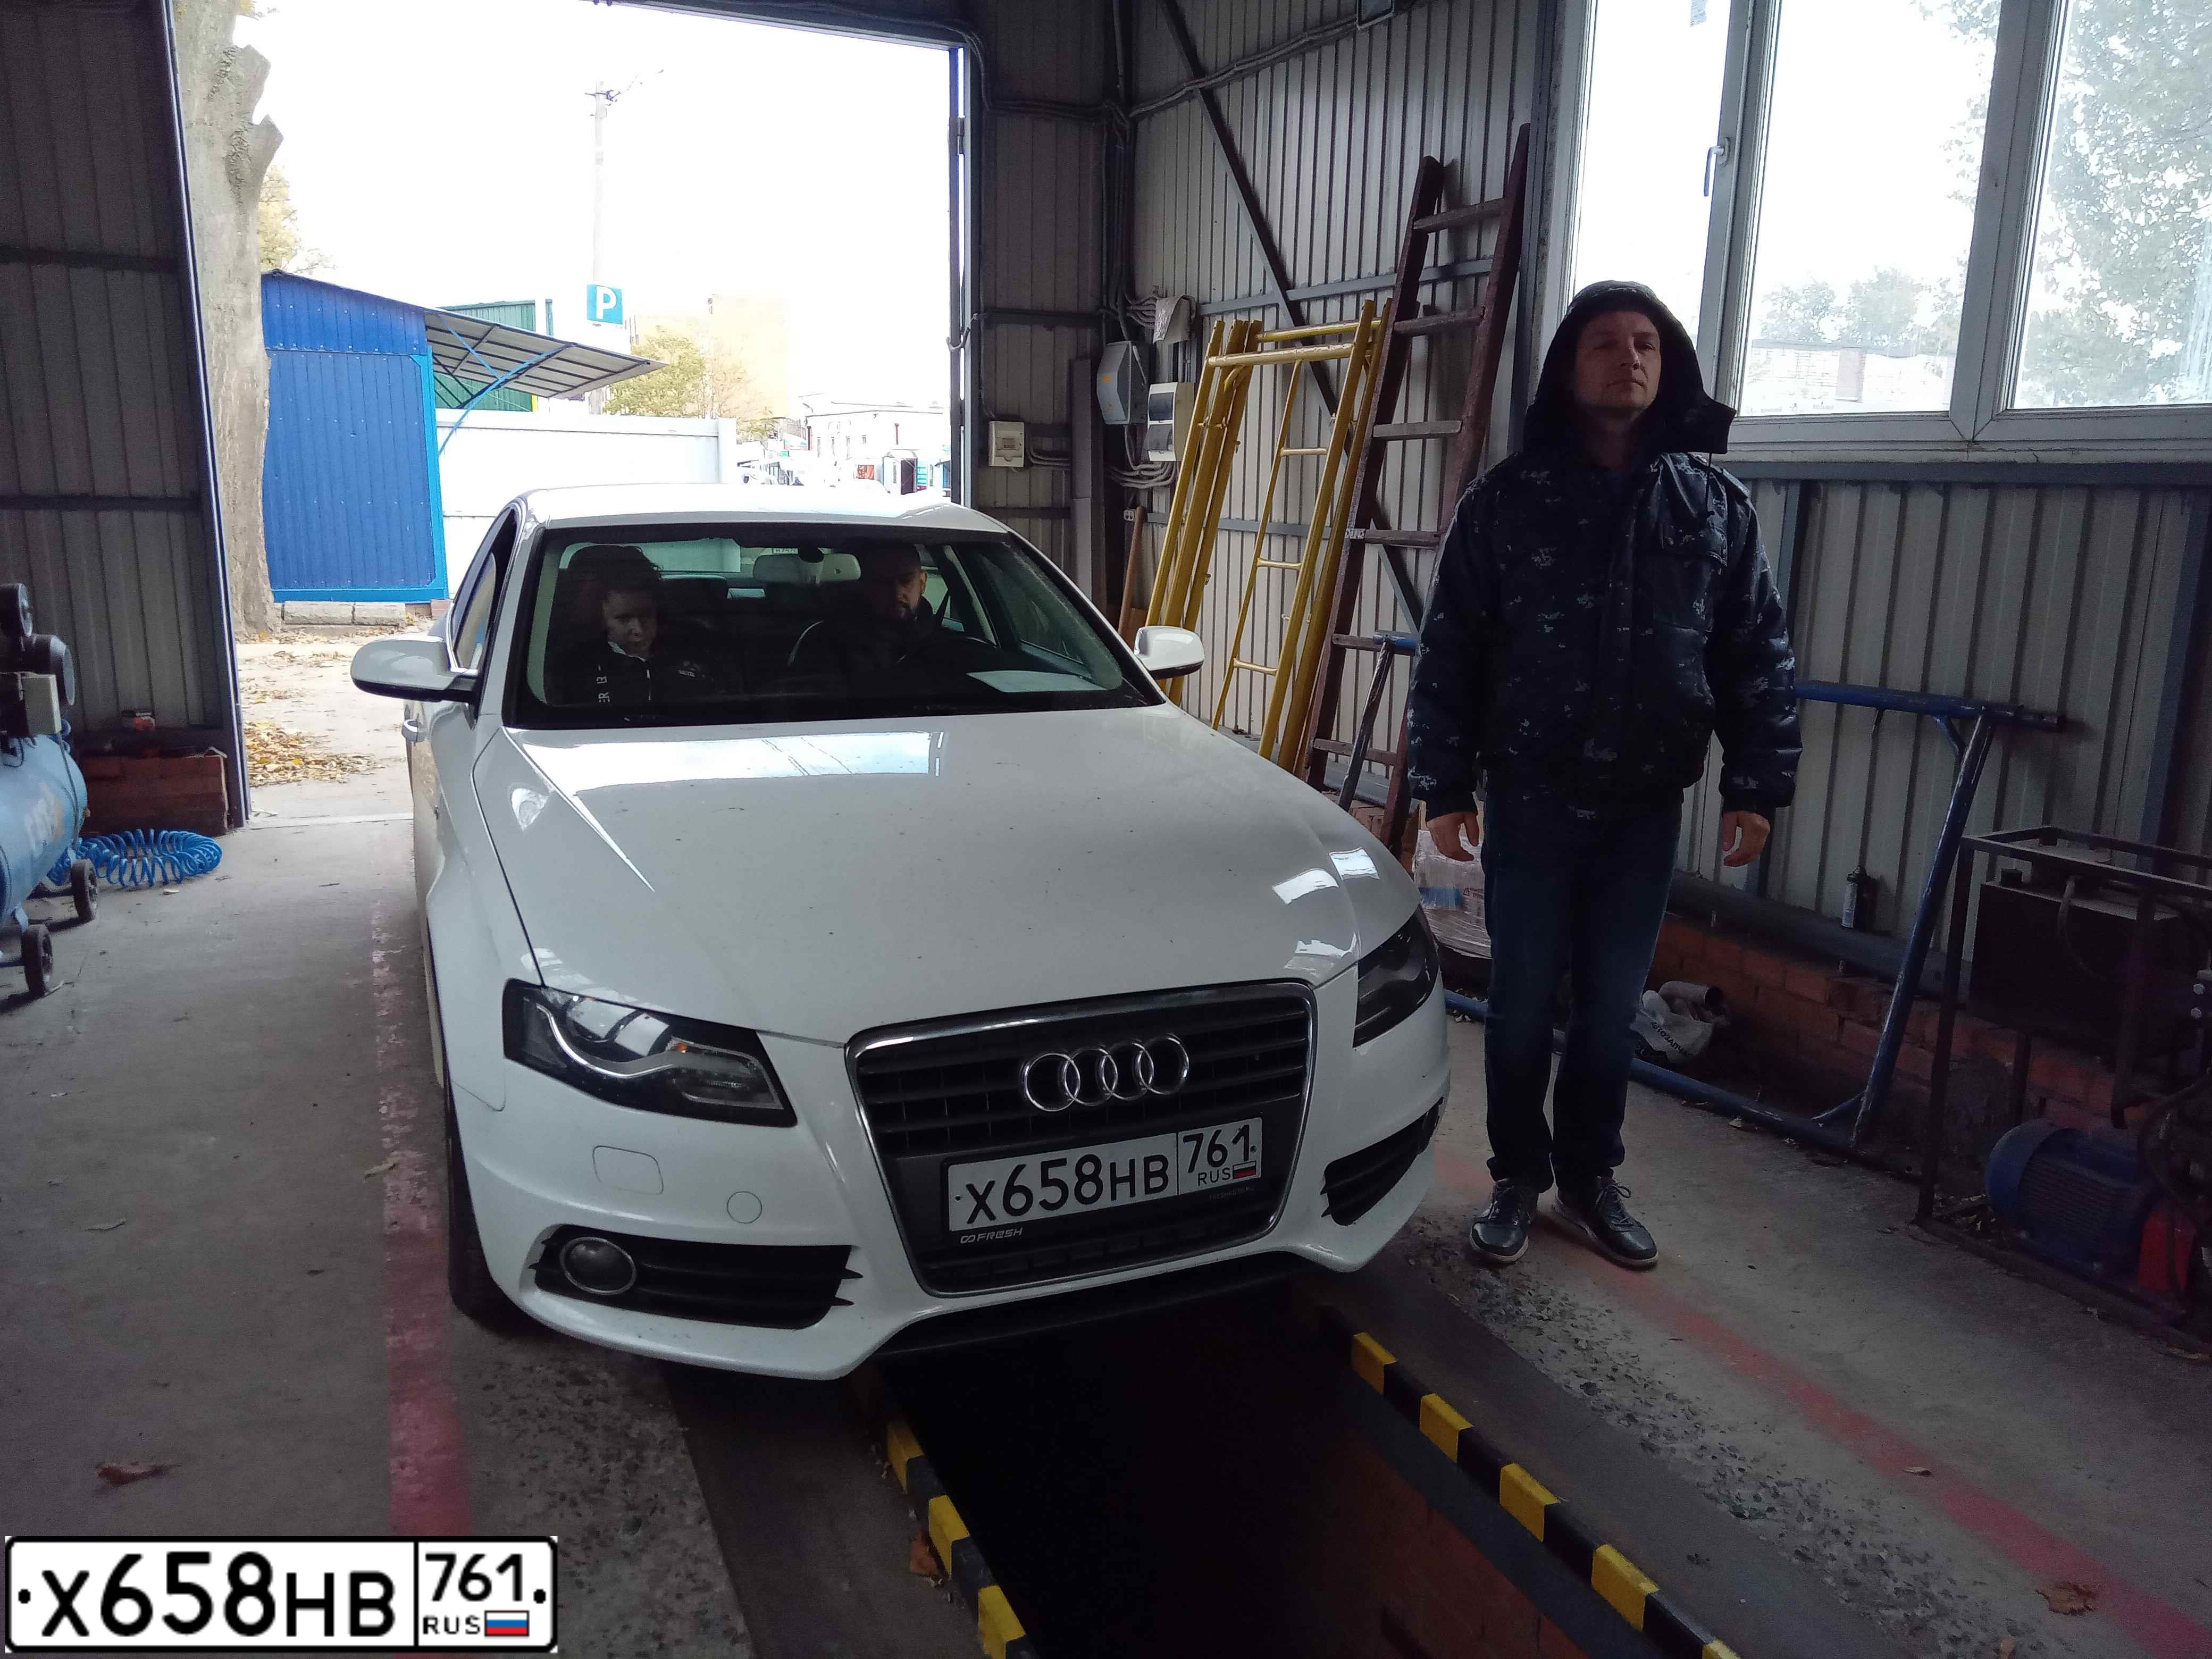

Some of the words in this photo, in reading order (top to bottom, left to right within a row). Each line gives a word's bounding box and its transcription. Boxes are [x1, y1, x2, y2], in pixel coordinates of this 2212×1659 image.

[596, 286, 617, 319] P
[1183, 1124, 1250, 1174] 761
[1198, 1167, 1231, 1186] RUS
